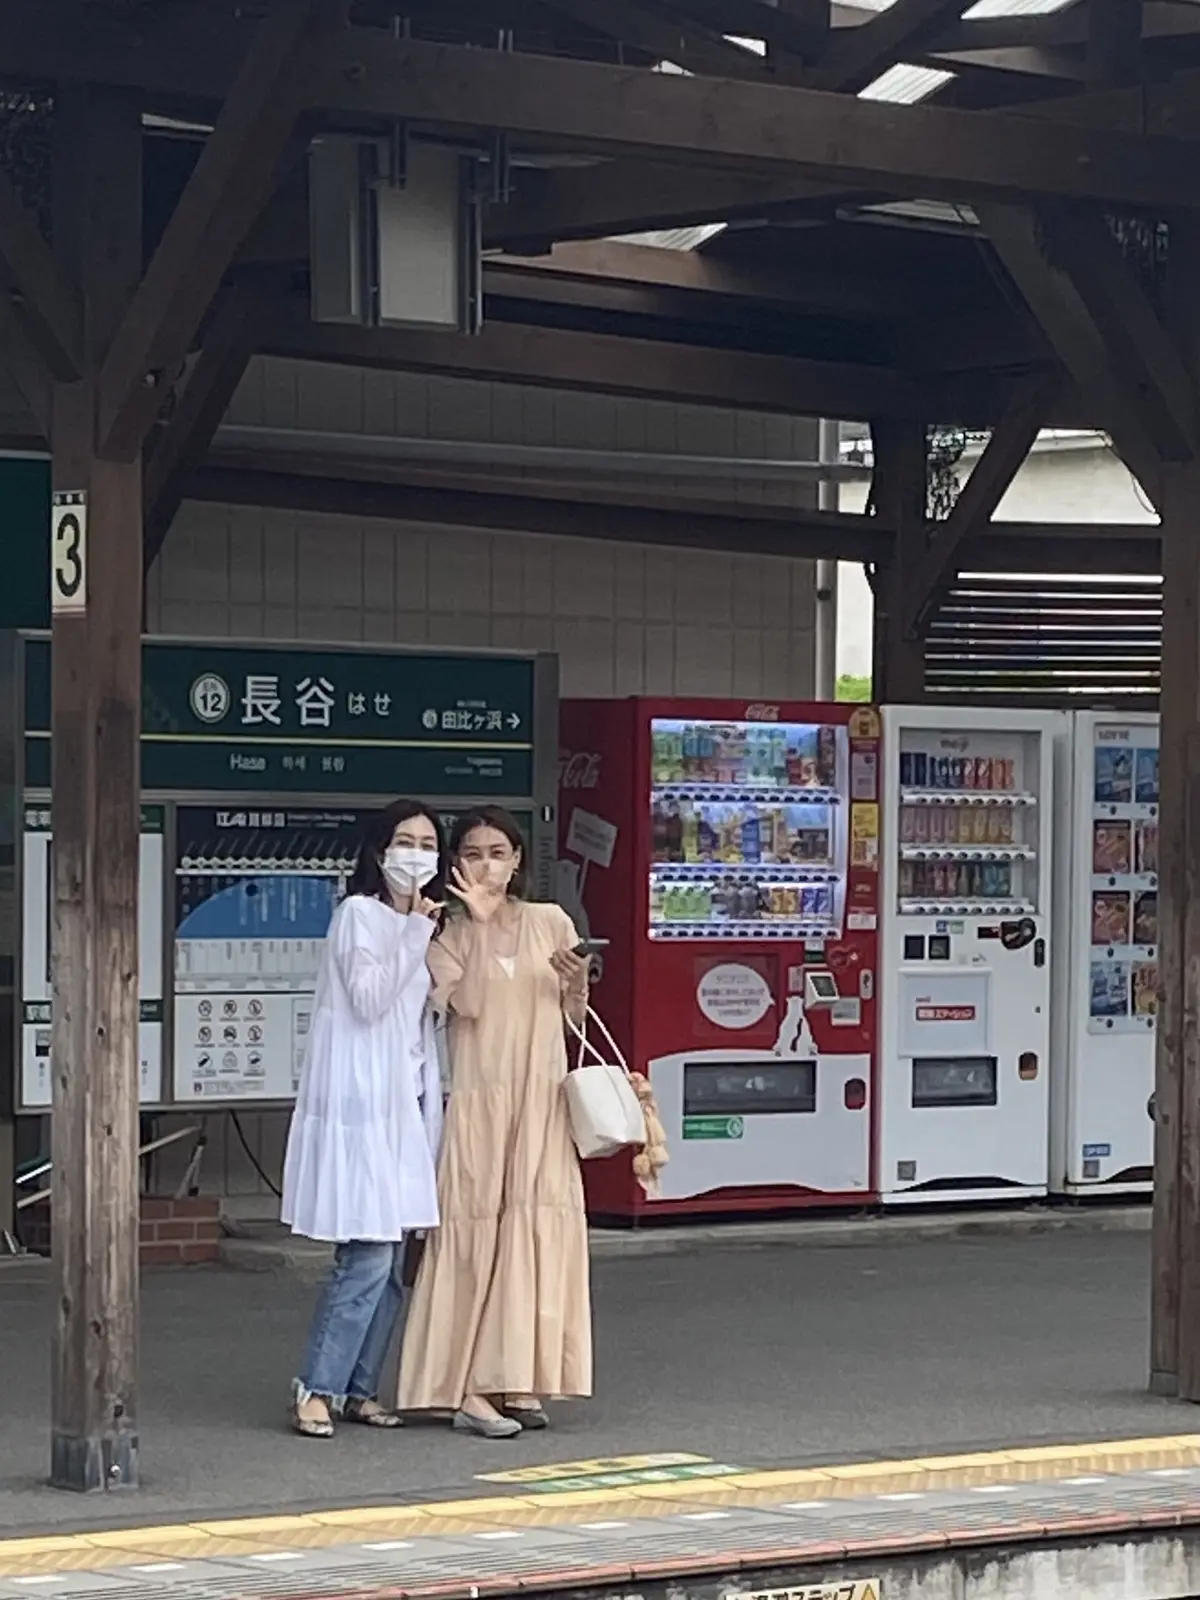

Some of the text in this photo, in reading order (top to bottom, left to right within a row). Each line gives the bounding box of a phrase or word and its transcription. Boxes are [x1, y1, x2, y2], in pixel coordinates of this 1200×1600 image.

[56, 513, 82, 597] 3
[200, 693, 223, 712] 12
[241, 675, 392, 727] 長谷 はせ
